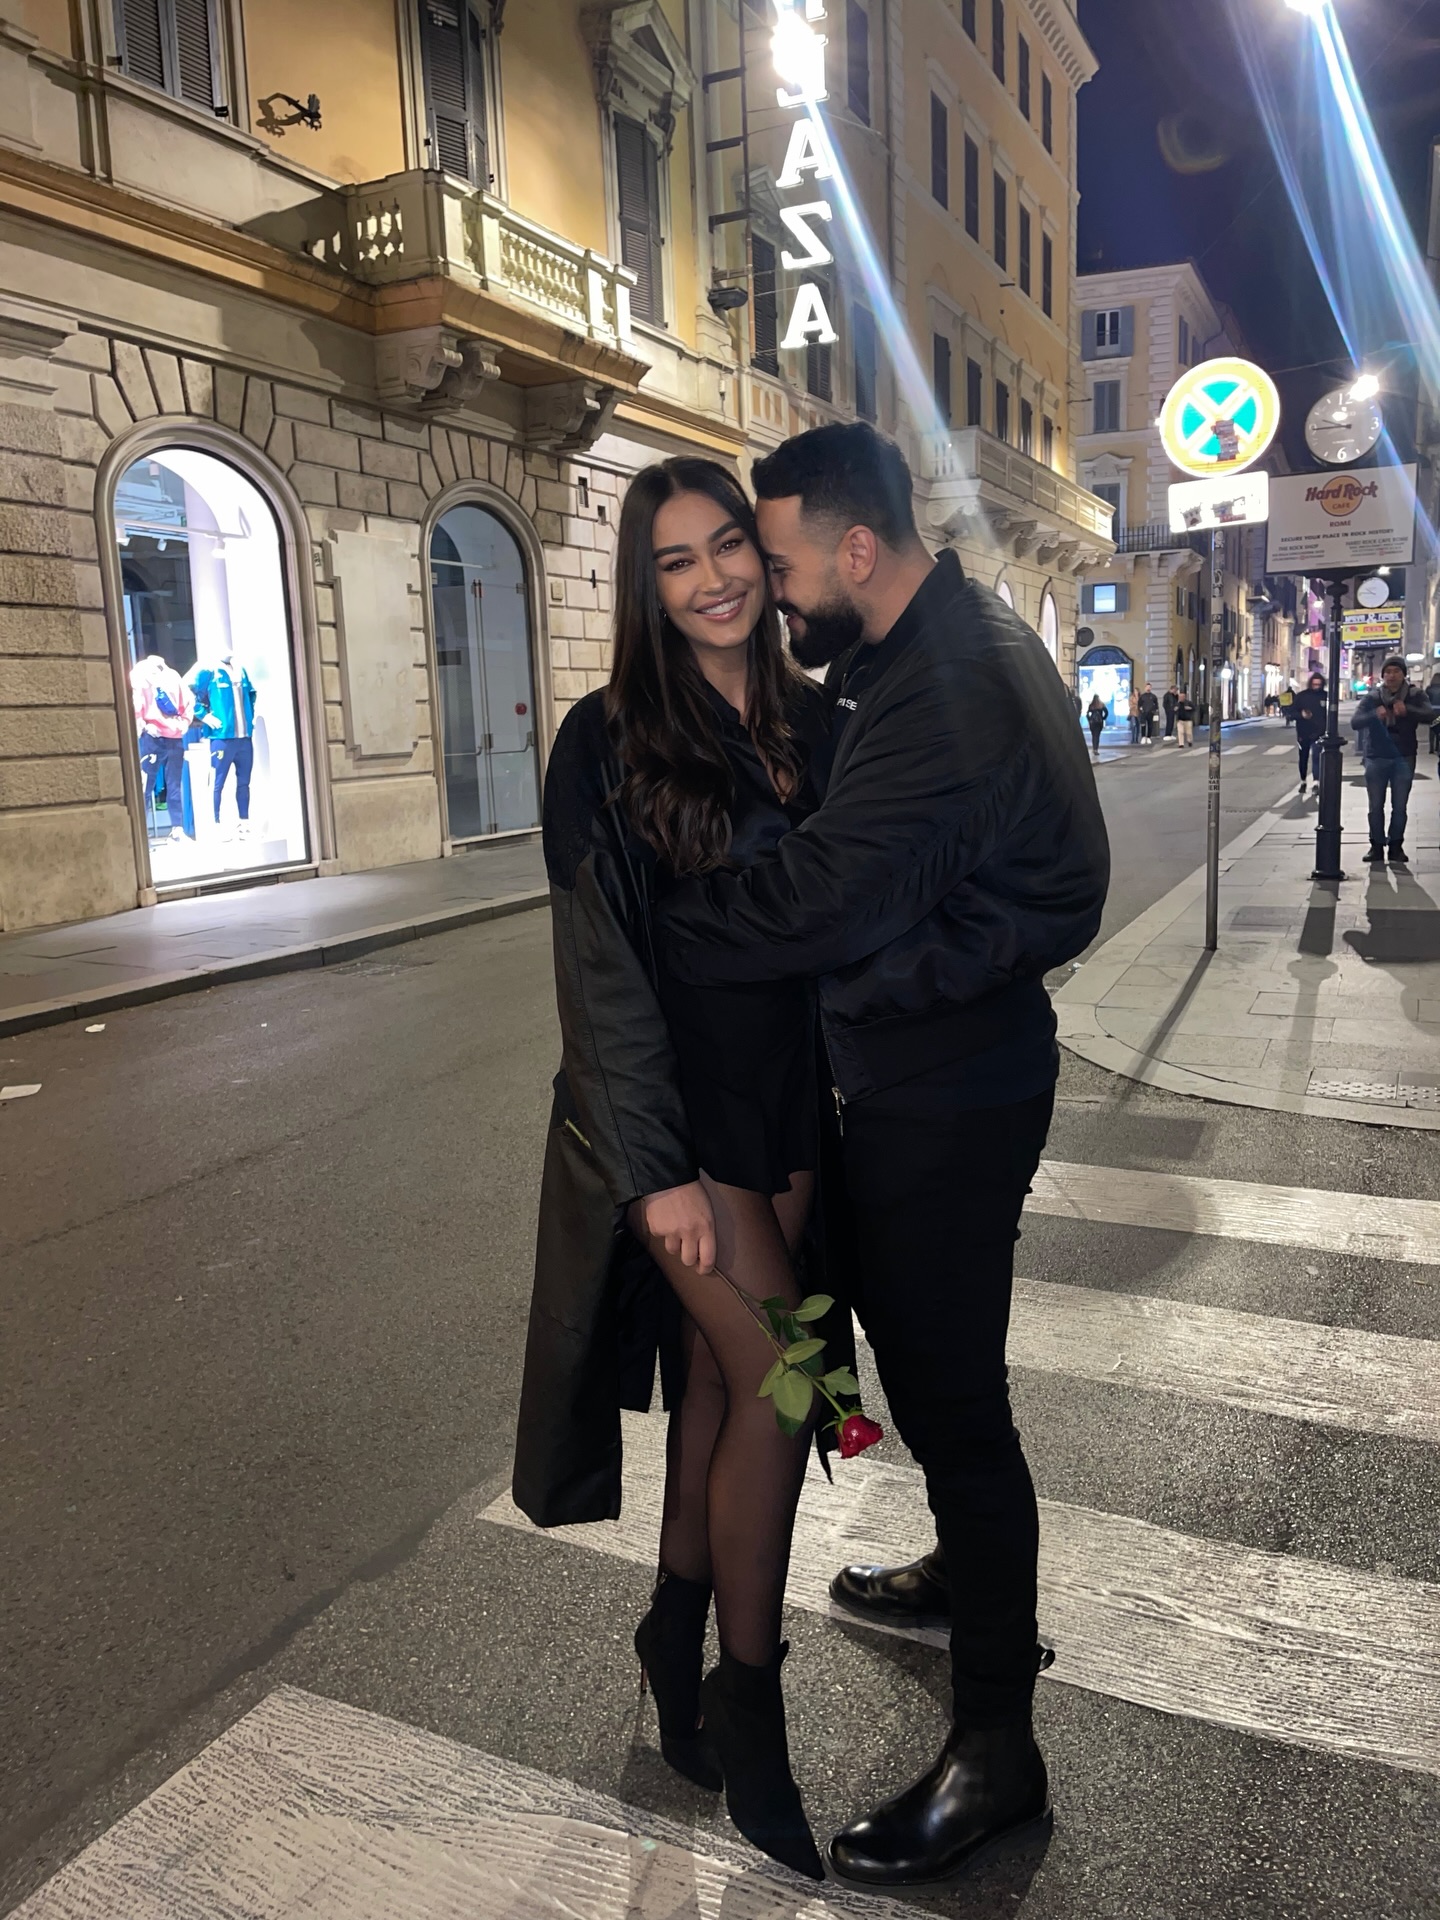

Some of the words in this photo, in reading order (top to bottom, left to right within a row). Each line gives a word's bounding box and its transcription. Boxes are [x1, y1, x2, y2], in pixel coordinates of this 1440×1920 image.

[1370, 417, 1379, 430] 3
[1336, 446, 1347, 460] 6
[1305, 484, 1342, 502] Hard
[1343, 481, 1378, 500] Rock
[1332, 502, 1351, 510] CAFE
